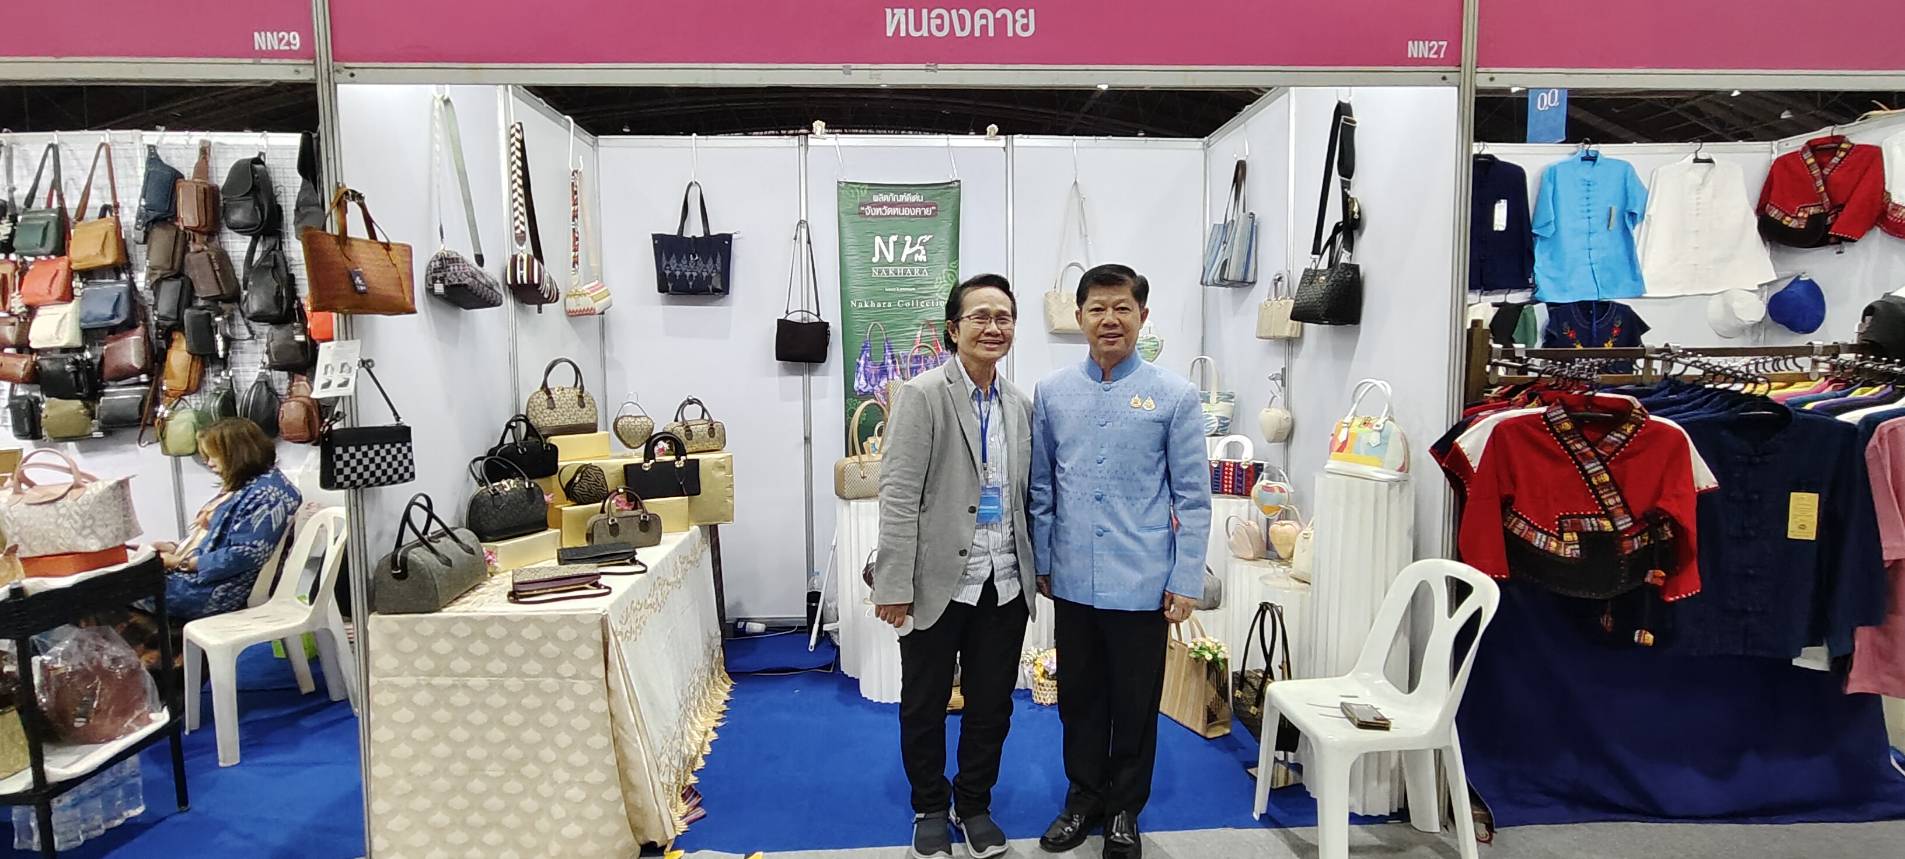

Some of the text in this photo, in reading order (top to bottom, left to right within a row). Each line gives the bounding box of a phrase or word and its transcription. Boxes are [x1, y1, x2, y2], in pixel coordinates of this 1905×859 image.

[885, 8, 1035, 37] หนองคาย
[253, 31, 300, 50] NN29
[1407, 40, 1448, 58] NN27
[871, 267, 929, 277] NAKHARA
[850, 299, 945, 308] Nakhara Collectio
